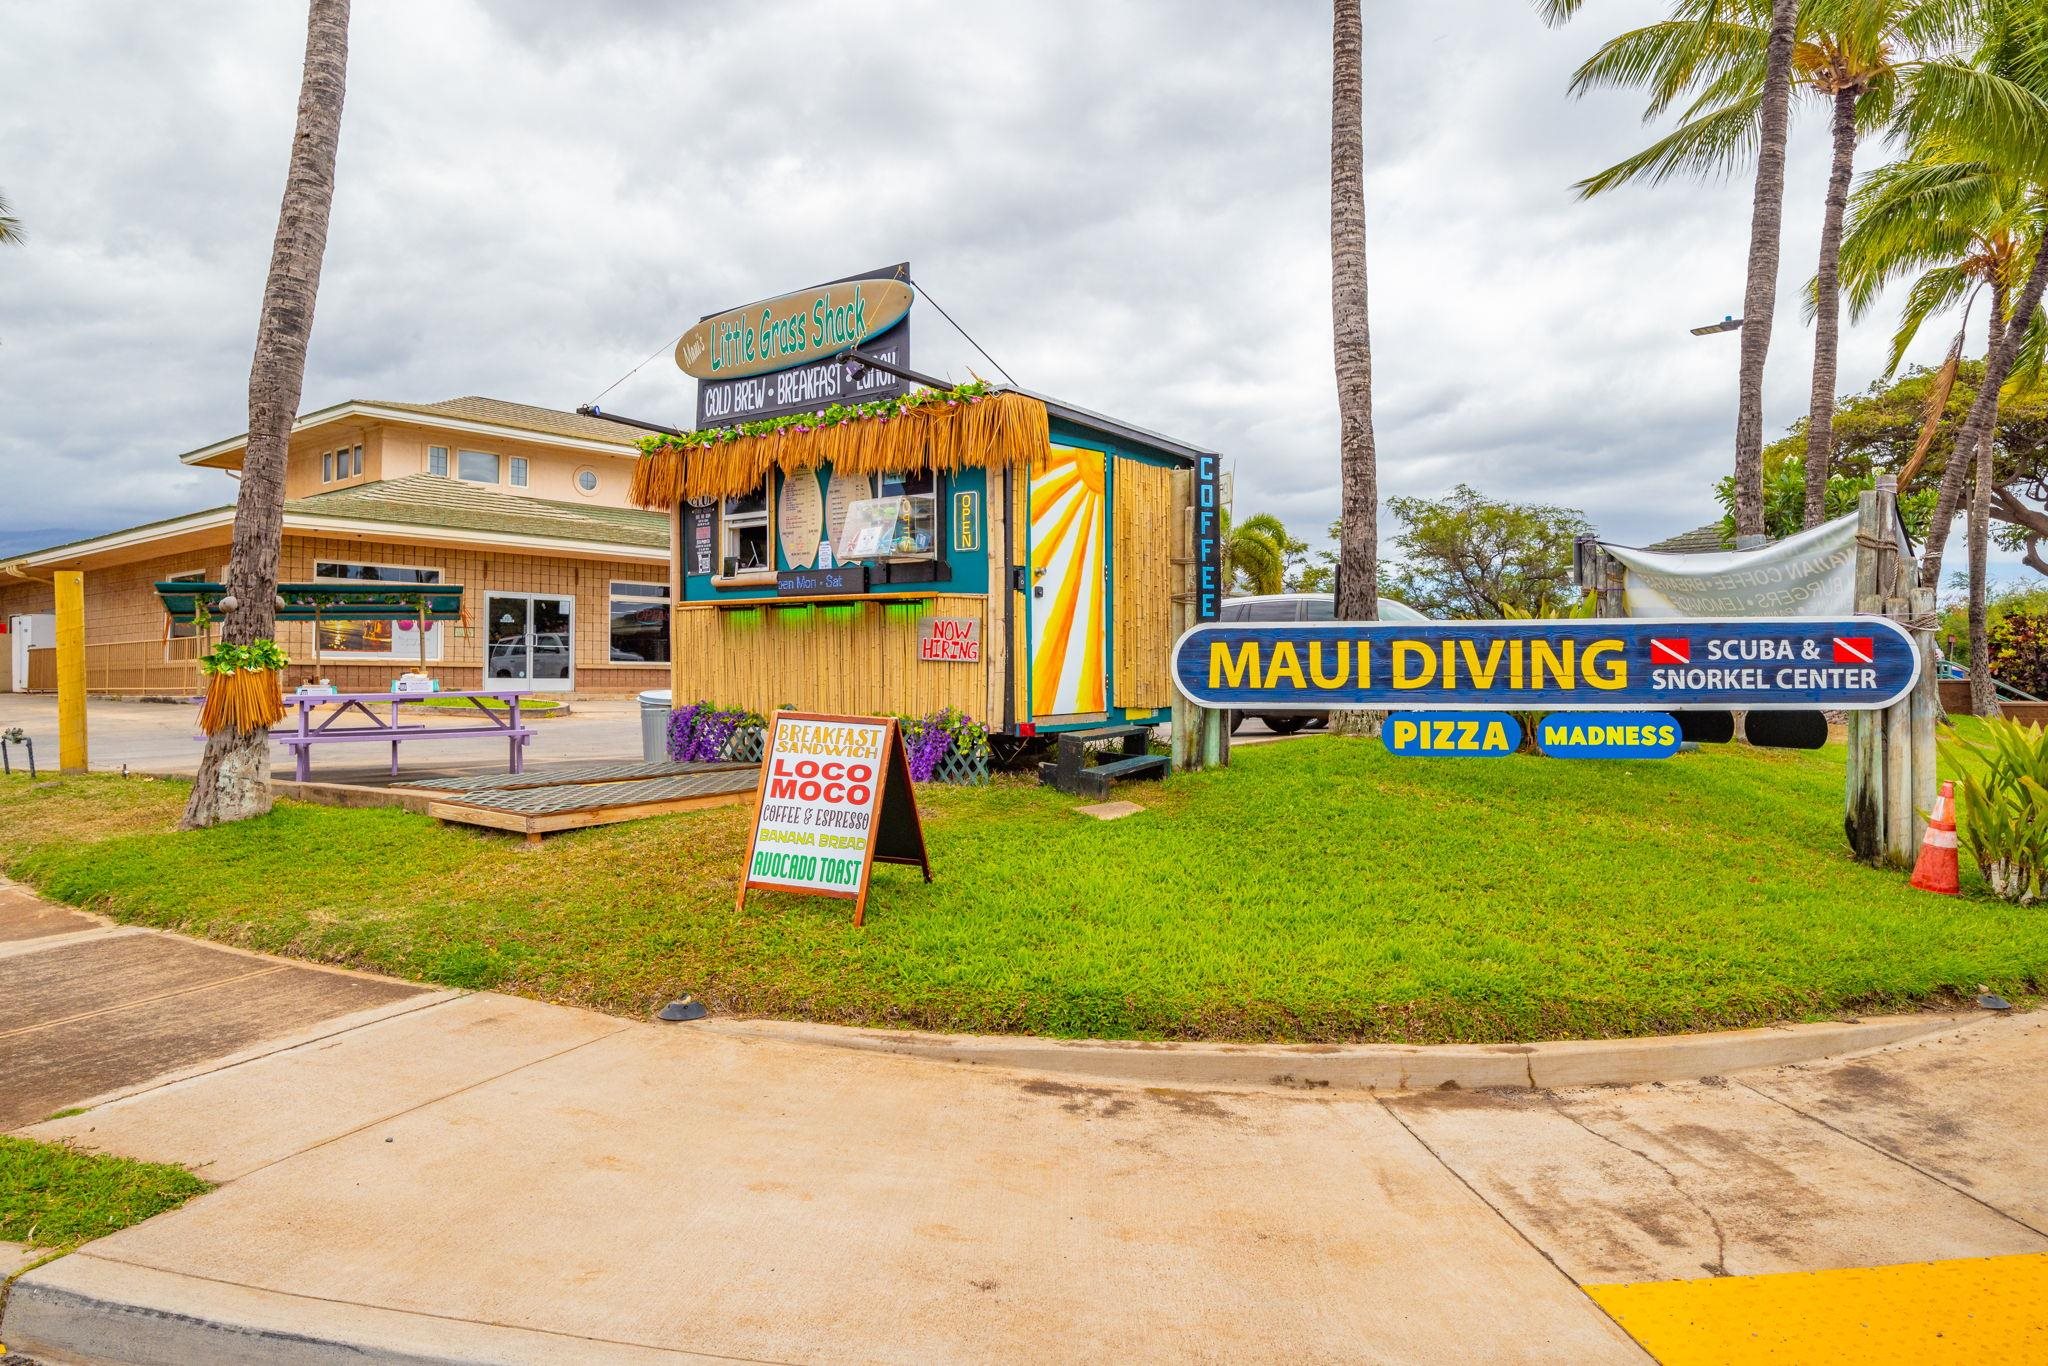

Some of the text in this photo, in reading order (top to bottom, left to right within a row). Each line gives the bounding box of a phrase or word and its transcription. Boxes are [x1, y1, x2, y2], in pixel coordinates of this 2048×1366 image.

[710, 312, 755, 372] Little
[759, 307, 807, 360] Grass
[812, 284, 867, 349] Shack
[705, 386, 731, 418] COLD
[734, 377, 766, 412] BREW
[777, 362, 843, 405] BREAKFAST
[961, 494, 972, 548] OPEN
[1200, 457, 1215, 617] COFFEE
[796, 576, 817, 589] Mon
[825, 574, 843, 588] Sat
[933, 620, 973, 640] NOW
[922, 638, 979, 660] HIRING
[1707, 639, 1820, 661] SCUBA &
[1208, 640, 1628, 690] MAUI DIVING
[1652, 667, 1878, 690] SNORKEL CENTER
[777, 723, 882, 747] BREAKFAST
[1394, 720, 1510, 751] PIZZA
[1544, 725, 1675, 746] MADNESS
[775, 740, 880, 760] SANDWICH
[773, 758, 872, 783] LOCO
[770, 778, 871, 805] MOCO
[763, 804, 870, 830] COFFEE & ESPRESSO
[759, 828, 867, 851] BANANA BREAD
[752, 851, 862, 886] AVOCADO TOAST
